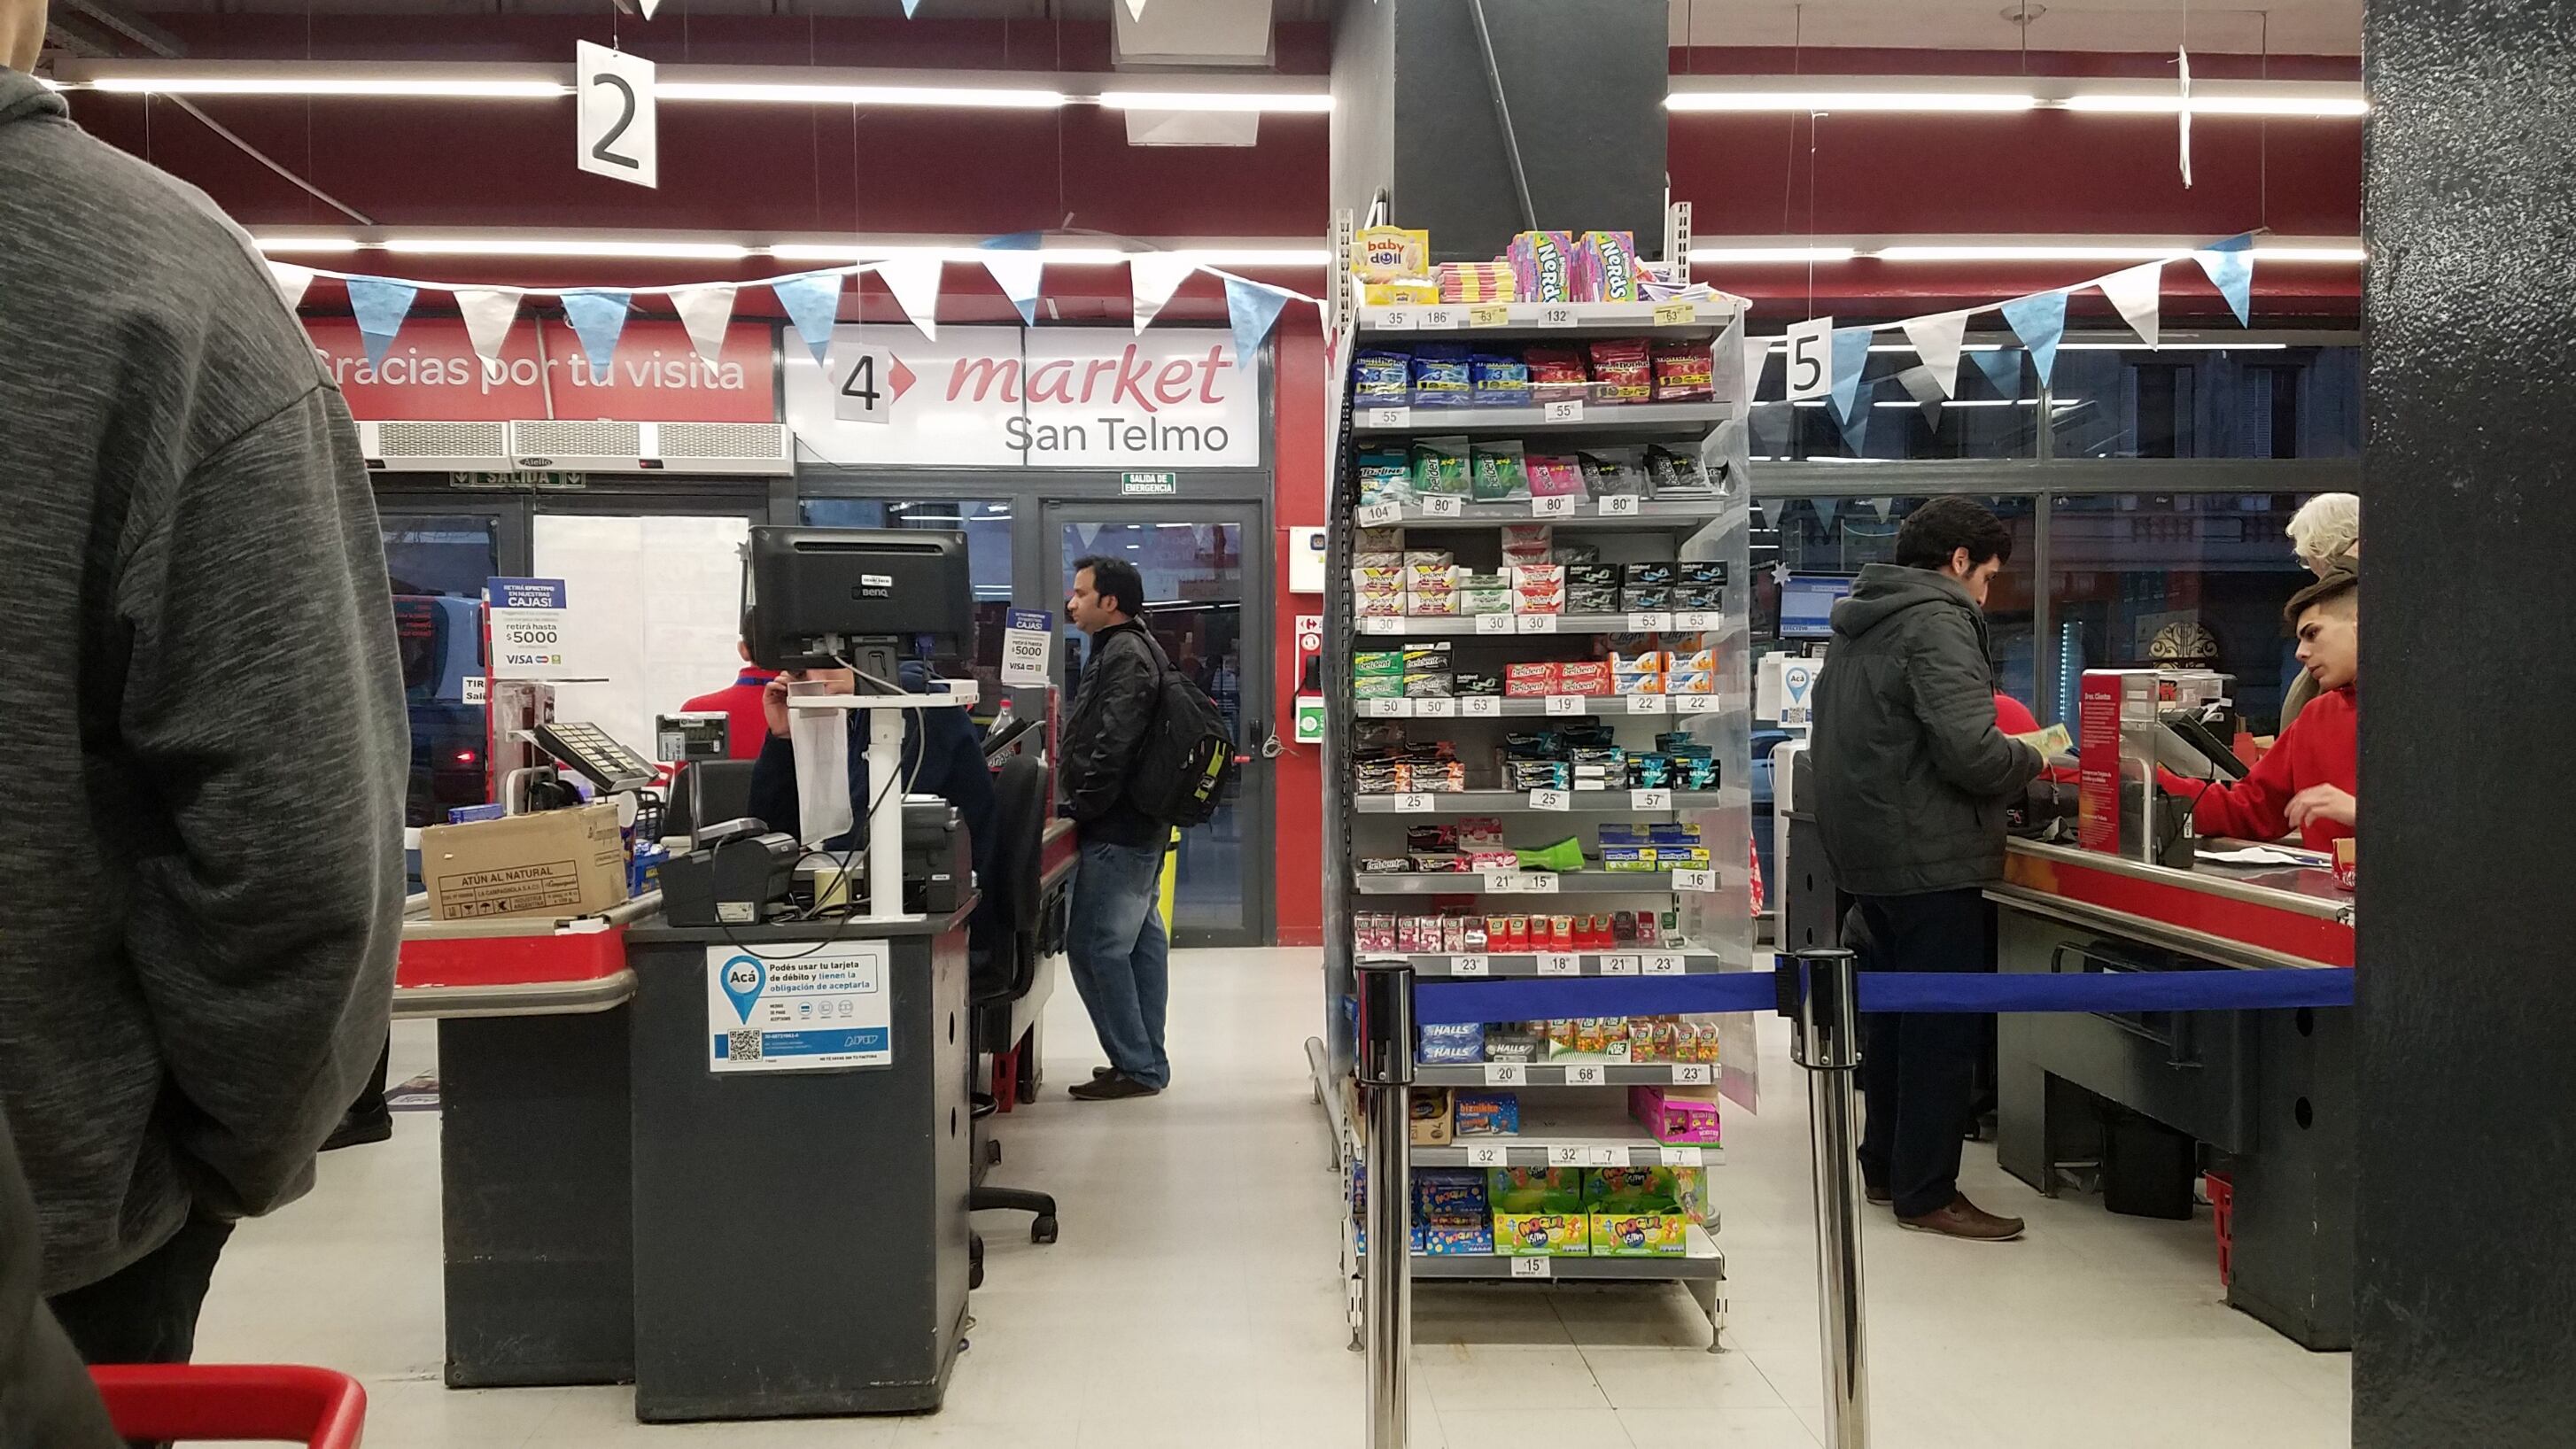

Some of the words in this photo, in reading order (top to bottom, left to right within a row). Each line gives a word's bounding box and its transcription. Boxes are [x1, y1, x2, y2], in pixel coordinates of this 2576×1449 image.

[592, 73, 639, 170] 2
[1368, 238, 1404, 252] baby
[1793, 335, 1821, 391] 5
[481, 358, 559, 395] por
[567, 353, 615, 387] tu
[625, 351, 744, 390] visita
[944, 343, 1233, 413] market
[841, 355, 881, 411] 4
[1005, 416, 1086, 452] San
[1098, 416, 1229, 452] Telmo
[487, 471, 550, 484] SALIDA
[1129, 474, 1155, 484] SALIDA
[1157, 475, 1168, 484] DE
[1125, 483, 1172, 493] EMERGENCIA
[506, 655, 533, 664] VISA
[1010, 662, 1025, 670] VISA
[462, 874, 488, 887] ATÚN
[490, 873, 503, 882] AL
[505, 866, 553, 880] NATURAL
[769, 963, 795, 972] Podés
[830, 961, 859, 971] tarjeta
[730, 969, 756, 983] Acá
[769, 973, 780, 982] de
[782, 972, 809, 982] débito
[770, 983, 815, 994] obligación
[829, 980, 870, 991] aceptarla
[1433, 1026, 1470, 1035] HALLS
[1434, 1047, 1470, 1058] HALLS
[1496, 1043, 1525, 1052] HALLS
[1518, 1216, 1565, 1237] MOGUL
[1615, 1216, 1662, 1237] MOGUL
